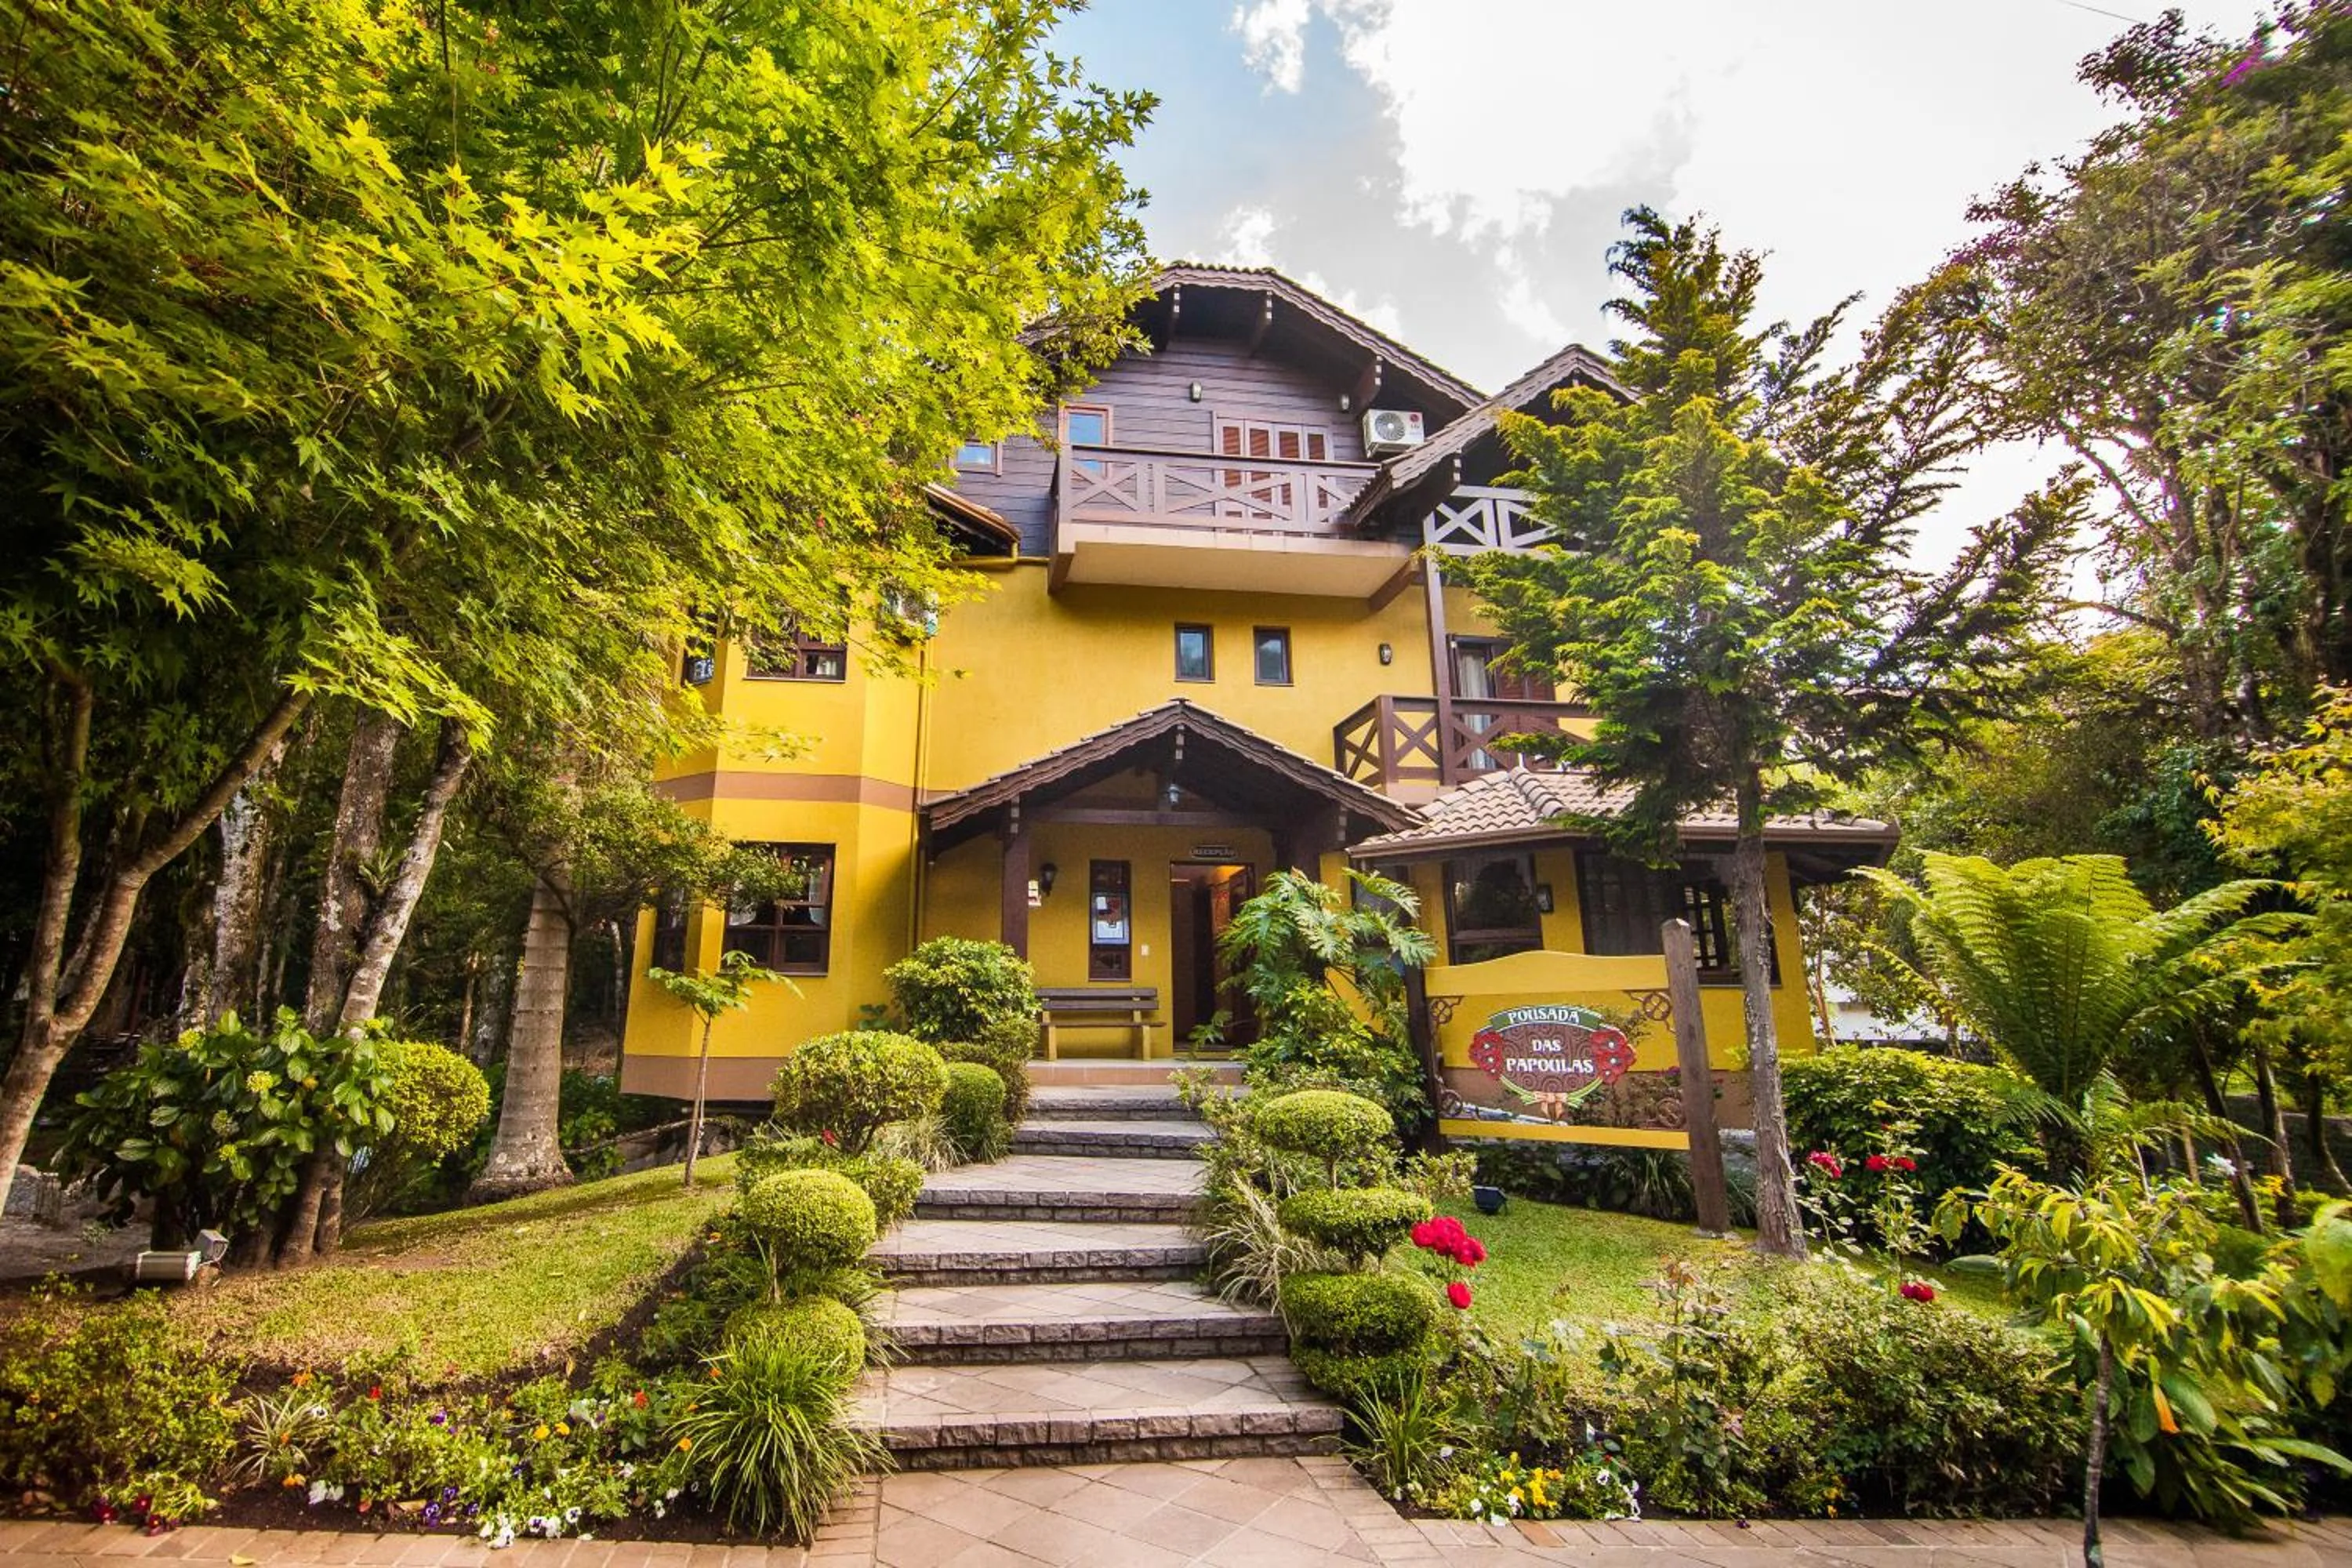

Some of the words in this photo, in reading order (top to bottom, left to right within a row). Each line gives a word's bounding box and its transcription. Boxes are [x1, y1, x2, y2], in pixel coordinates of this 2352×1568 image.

[1508, 1007, 1580, 1023] POUSADA
[1532, 1039, 1561, 1051] DAS
[1506, 1058, 1594, 1073] PAPOULAS
